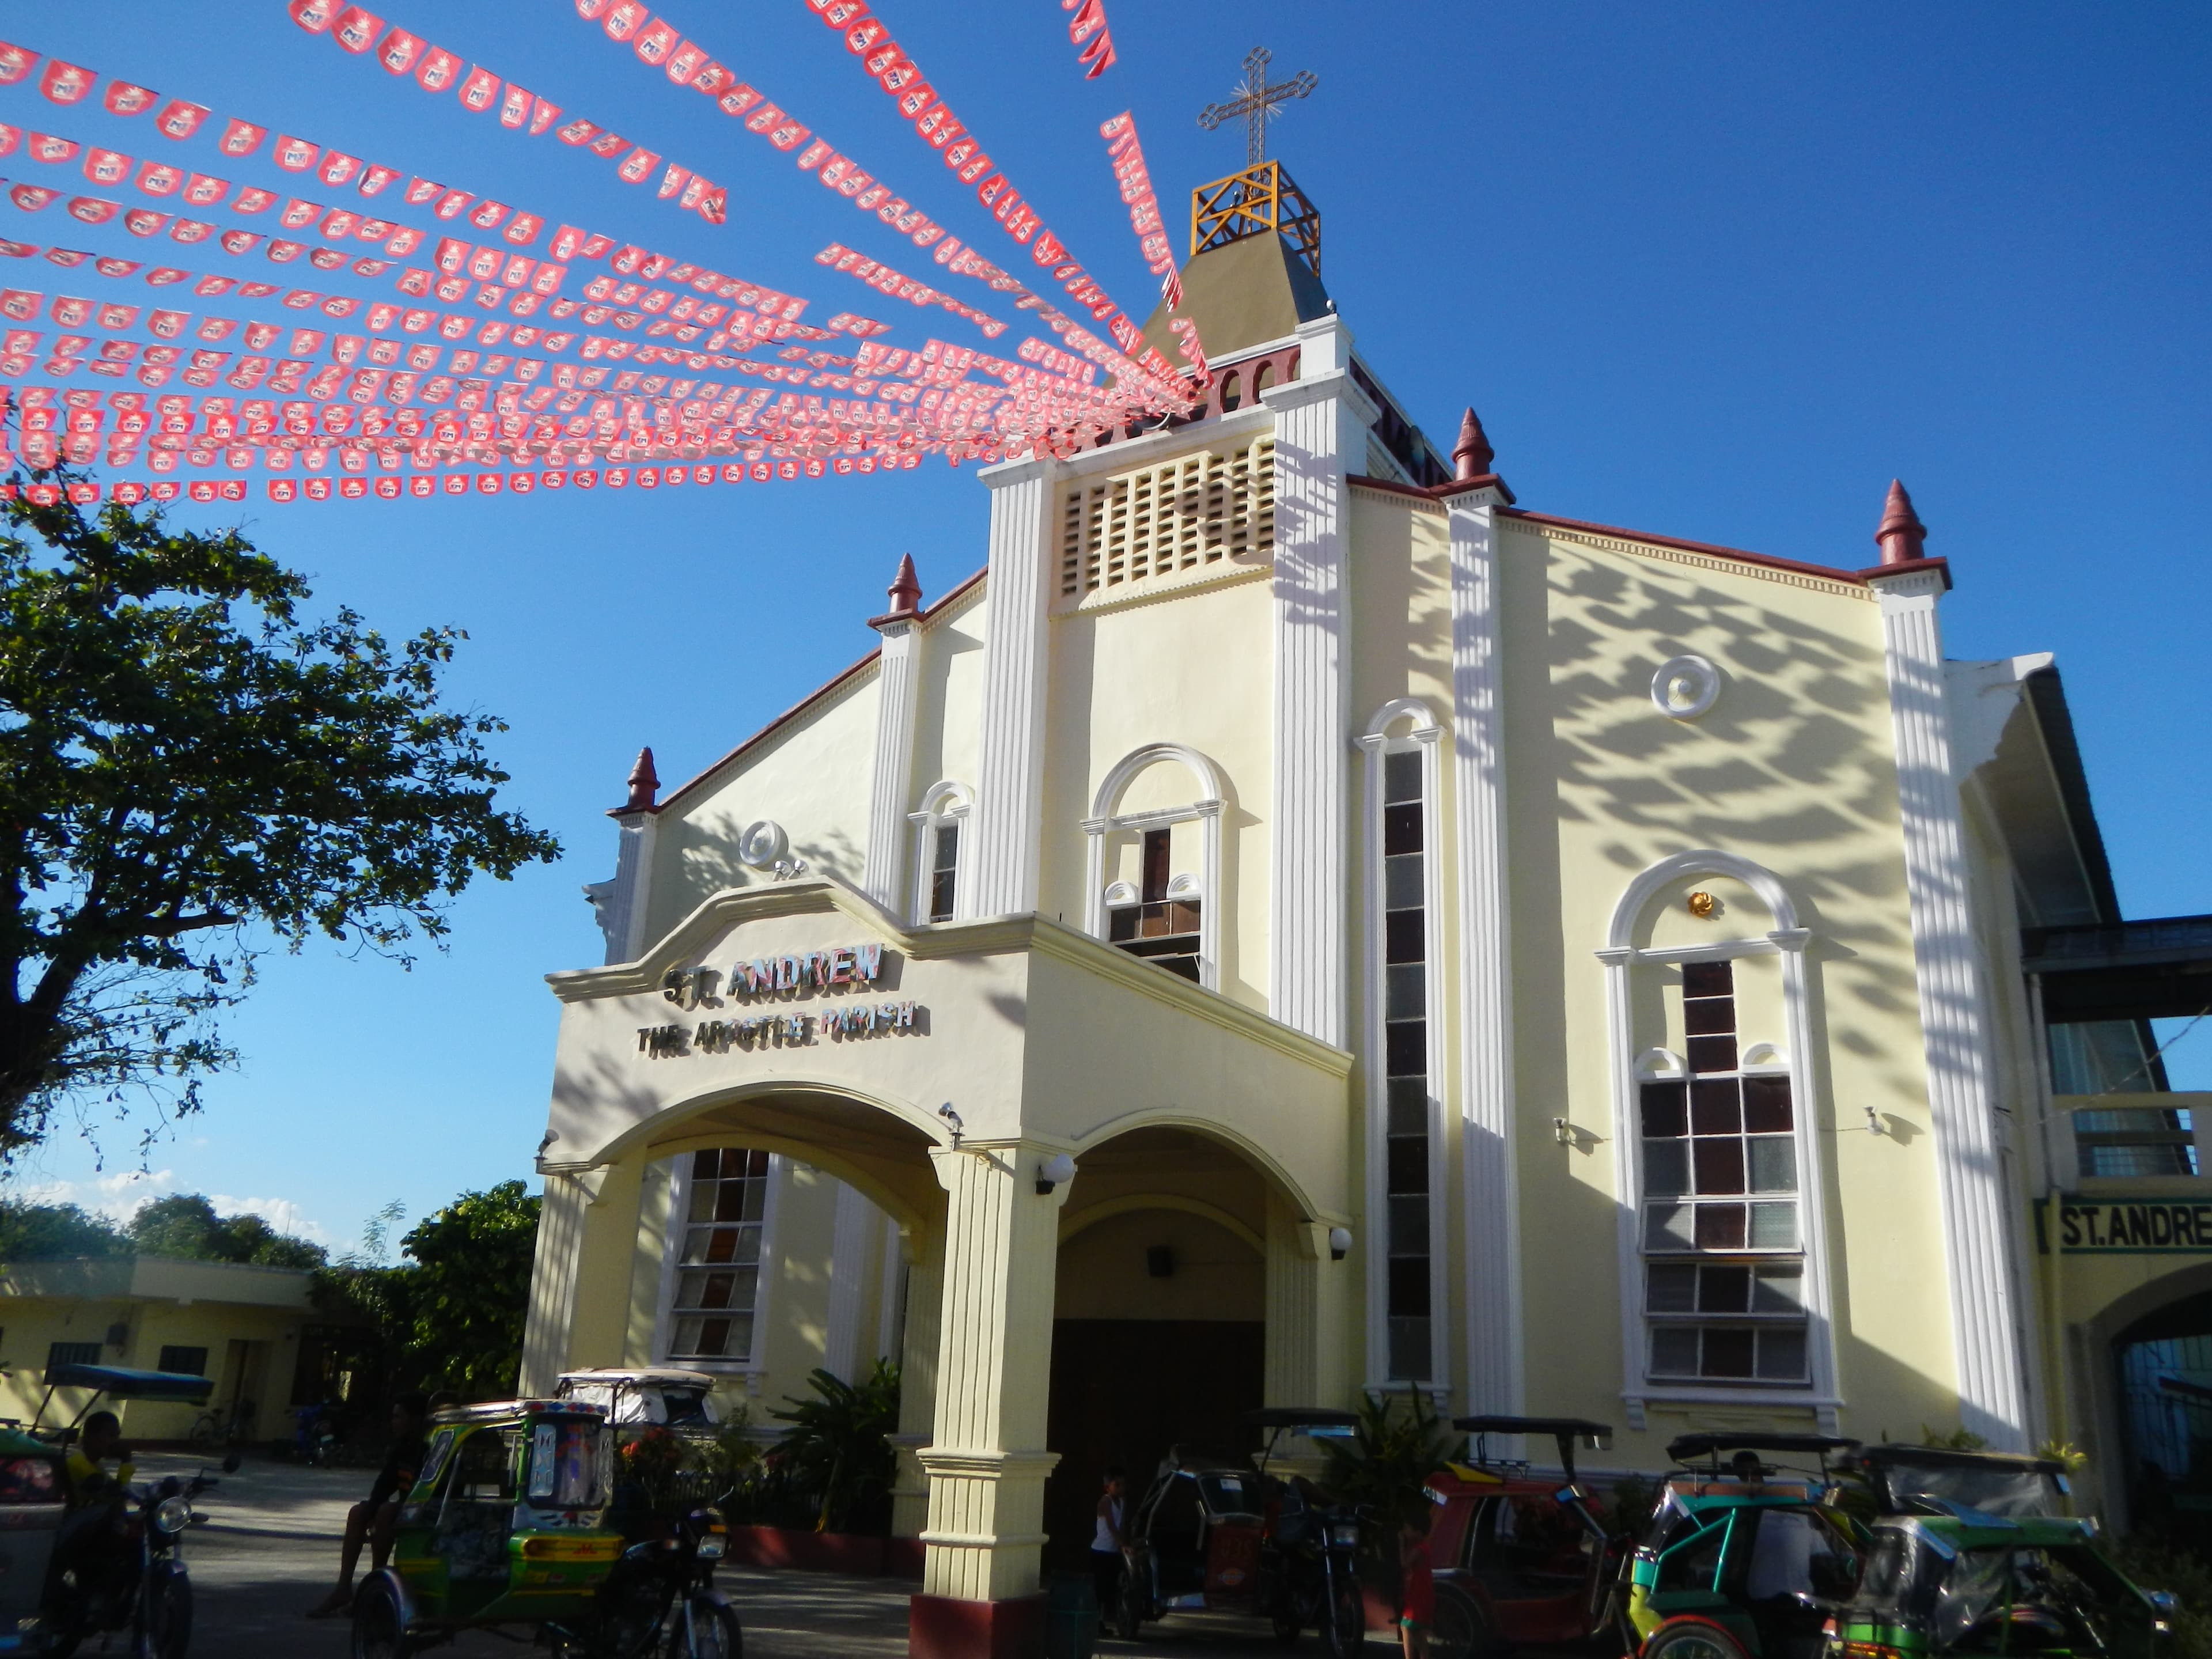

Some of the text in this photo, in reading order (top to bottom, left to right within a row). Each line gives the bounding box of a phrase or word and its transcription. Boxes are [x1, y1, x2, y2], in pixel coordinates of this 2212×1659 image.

[726, 943, 884, 996] ANDREW
[637, 1000, 915, 1052] THE APOSTLE PARISH
